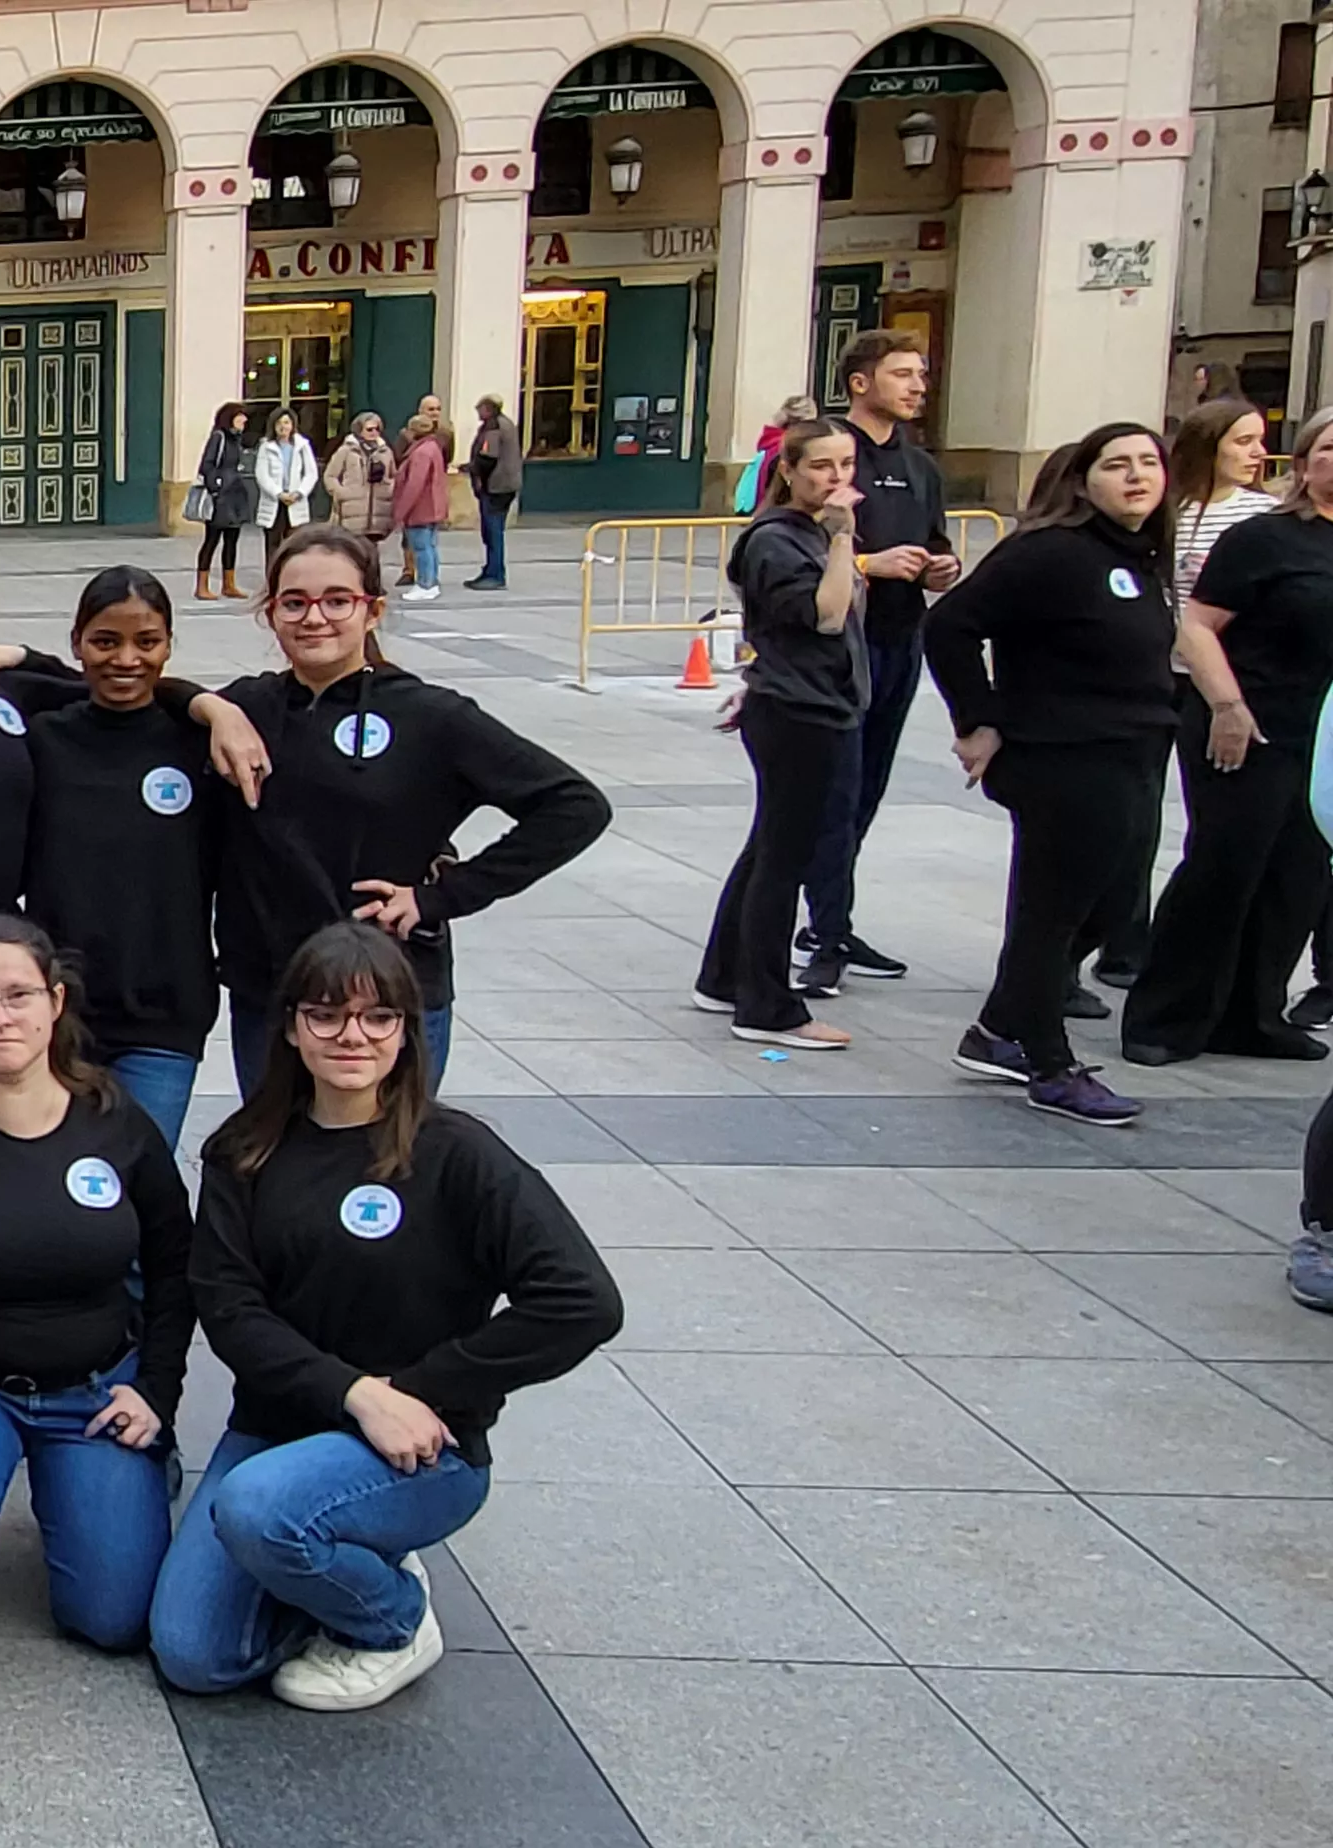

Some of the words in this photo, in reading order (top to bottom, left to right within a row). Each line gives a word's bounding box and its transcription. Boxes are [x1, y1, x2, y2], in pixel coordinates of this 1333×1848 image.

[609, 91, 623, 112] LA
[329, 107, 344, 129] LA
[347, 106, 406, 128] CONFIANZA
[10, 252, 150, 289] ULTRAMARINOS
